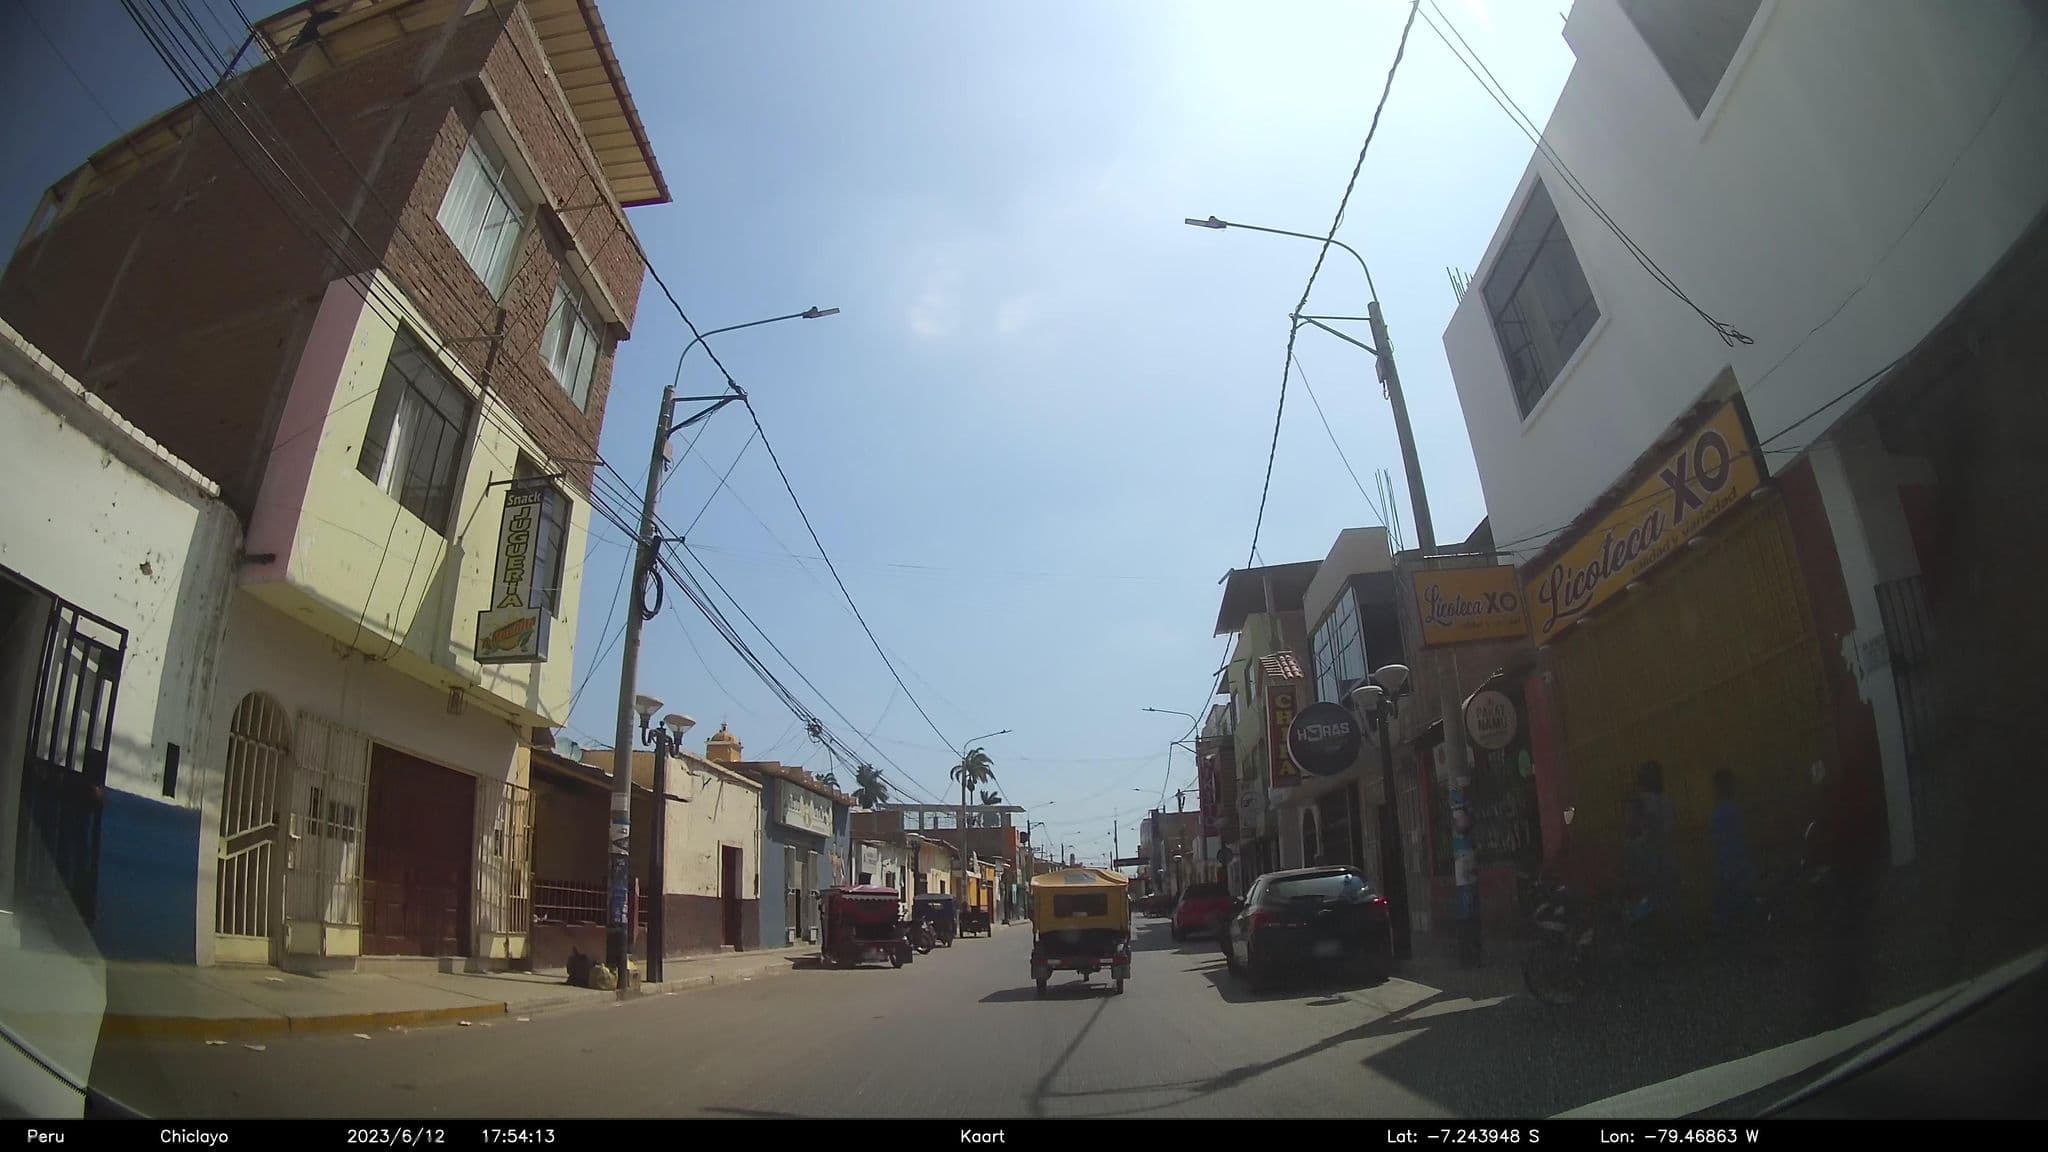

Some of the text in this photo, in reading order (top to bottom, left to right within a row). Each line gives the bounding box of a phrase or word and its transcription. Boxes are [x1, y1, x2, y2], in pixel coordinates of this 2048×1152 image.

[506, 491, 542, 507] Snack
[1539, 430, 1731, 634] Licoteca XO
[497, 506, 532, 608] JUGUERIA
[1424, 584, 1518, 627] Licoteca XO
